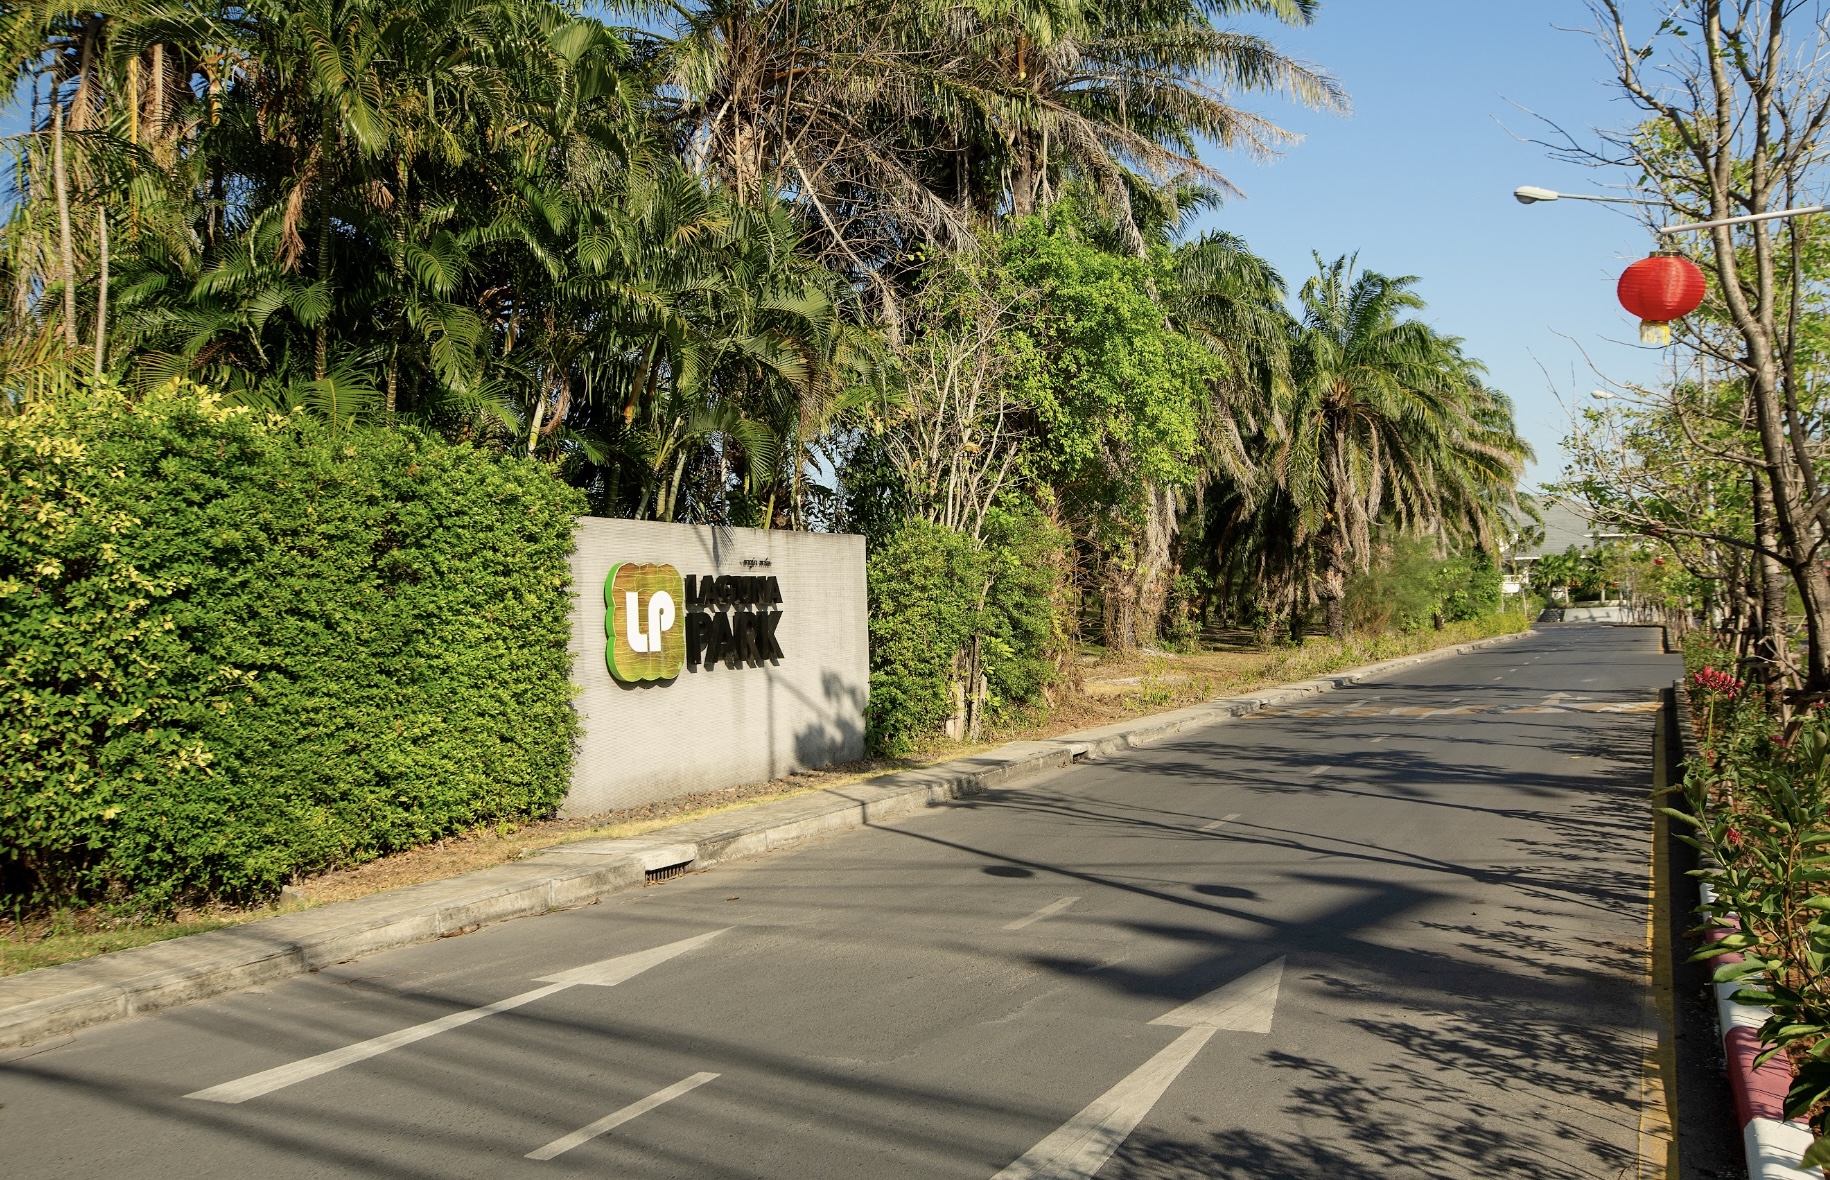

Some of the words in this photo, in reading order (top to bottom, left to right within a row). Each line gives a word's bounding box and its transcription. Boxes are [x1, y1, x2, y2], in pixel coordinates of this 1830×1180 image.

[685, 574, 783, 605] LAGUNA
[625, 590, 676, 653] LP
[685, 610, 785, 666] PARK
